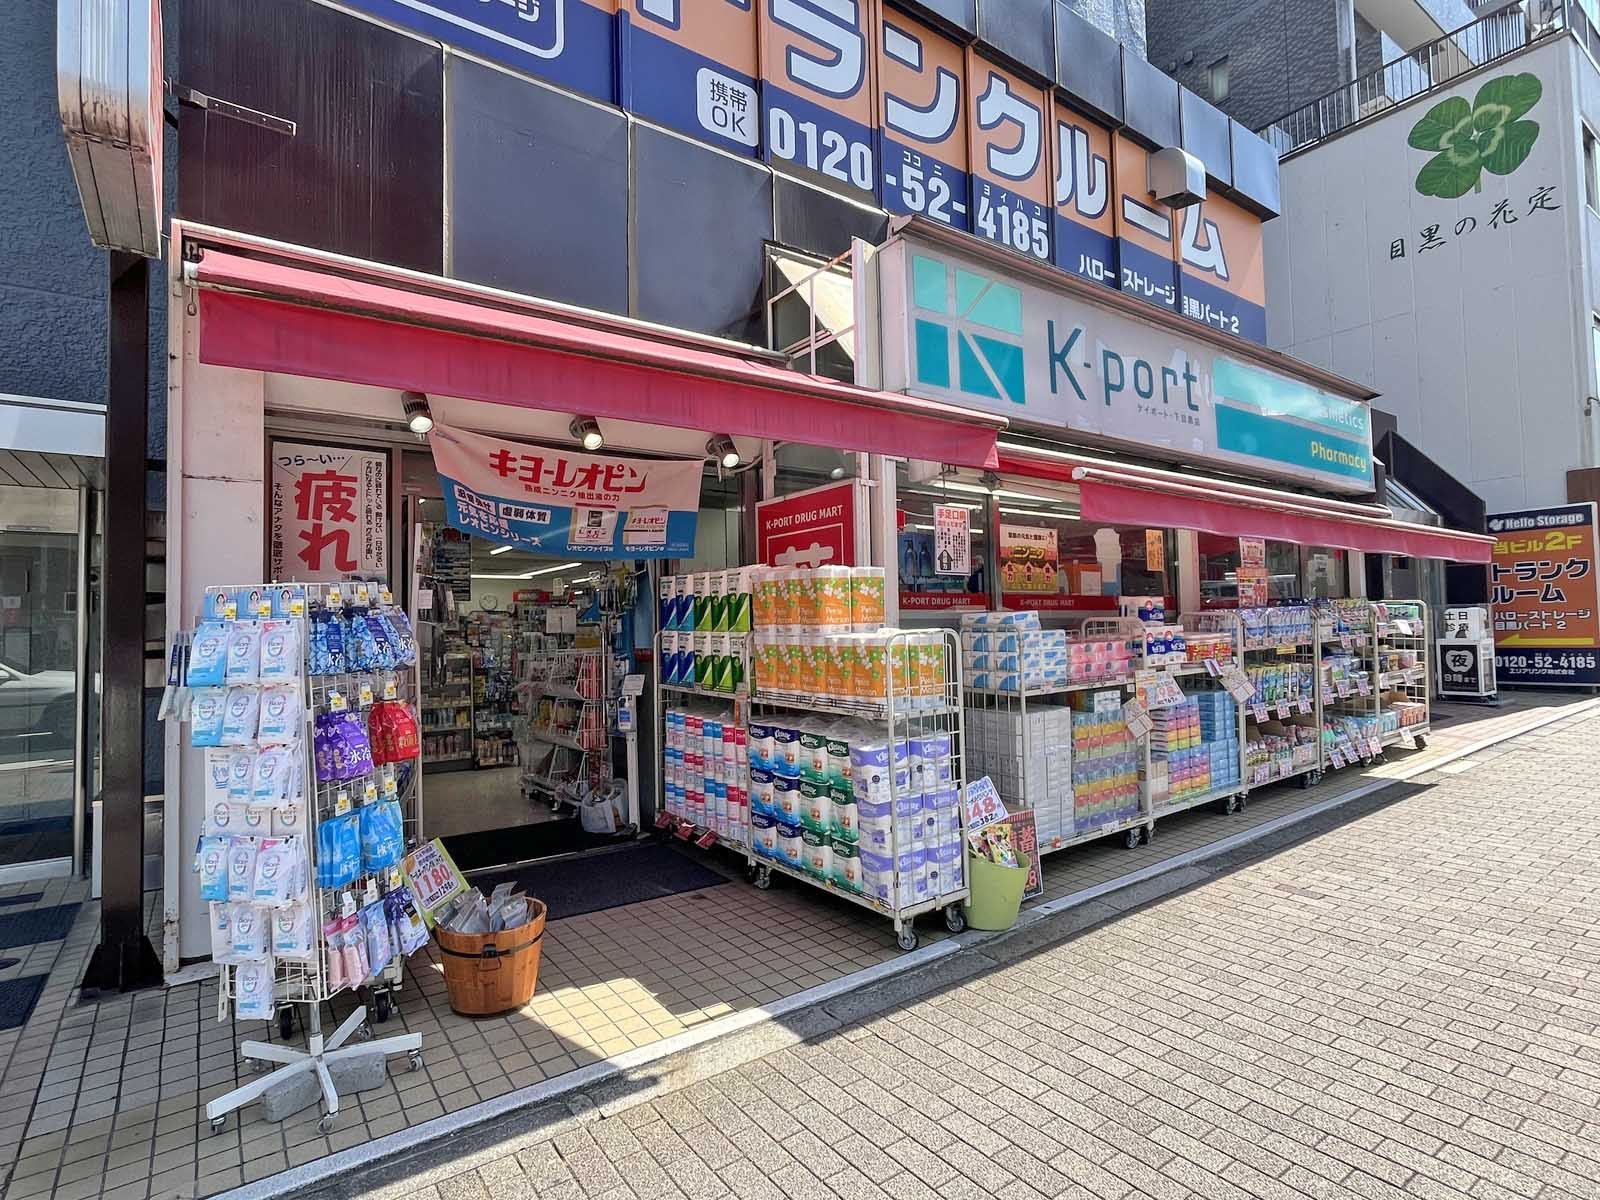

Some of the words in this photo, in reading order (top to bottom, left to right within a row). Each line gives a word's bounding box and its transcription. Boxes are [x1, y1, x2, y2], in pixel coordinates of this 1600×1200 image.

[709, 78, 748, 113] 携帯
[711, 105, 747, 138] OK
[1046, 318, 1200, 413] K-port
[1311, 441, 1367, 472] Pharmacy
[489, 449, 648, 493] キヨーレオピン
[294, 469, 358, 572] 疲れ
[503, 507, 547, 522] 虚弱体質
[766, 515, 793, 530] K-PORT
[795, 510, 816, 524] DRUG
[819, 505, 843, 519] MART
[1507, 518, 1535, 530] Hello
[1537, 513, 1585, 527] Storage
[1491, 558, 1590, 583] トランク
[931, 597, 951, 606] DRUG
[1491, 583, 1567, 604] ルーム
[1451, 654, 1468, 667] 夜
[1495, 656, 1596, 668] 0120-52-4185
